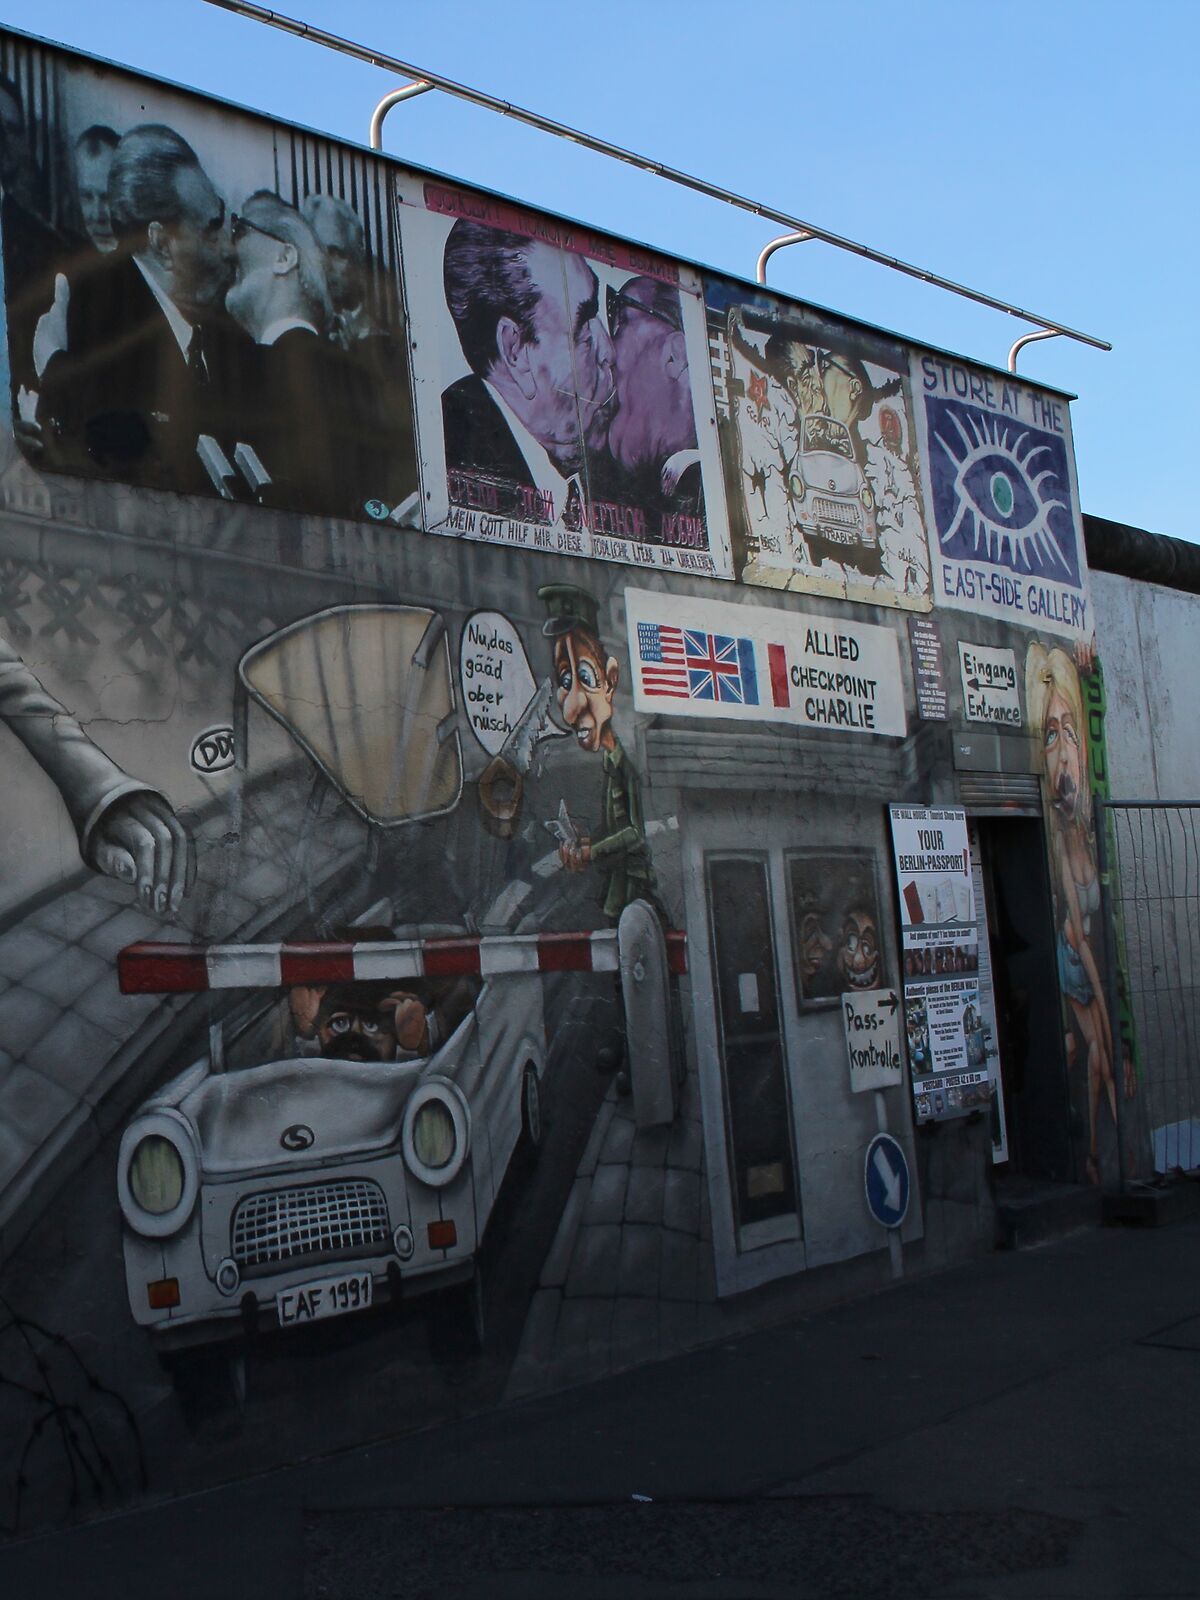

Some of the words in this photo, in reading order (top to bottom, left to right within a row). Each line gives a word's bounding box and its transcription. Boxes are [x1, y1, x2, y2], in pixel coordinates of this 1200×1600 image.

[922, 357, 996, 409] STORE
[1002, 387, 1021, 415] AT
[1029, 392, 1064, 432] THE
[446, 508, 475, 532] MEIN
[508, 521, 528, 542] HILF
[558, 533, 582, 551] DIESE
[943, 564, 1022, 610] EAST-SIDE
[1028, 584, 1087, 630] GALLERY
[468, 623, 513, 654] Nu,das
[804, 628, 860, 662] ALLIED
[790, 665, 877, 701] CHECKPOINT
[963, 652, 1016, 688] Eingang
[468, 686, 504, 706] ober
[968, 694, 1021, 723] Entrance
[472, 708, 512, 734] nüsch
[804, 698, 875, 730] CHARLIE
[917, 830, 944, 850] YOUR
[845, 1002, 884, 1031] Pass-
[849, 1040, 900, 1070] kontrolle
[280, 1288, 322, 1323] CAF
[329, 1277, 370, 1310] 1991
